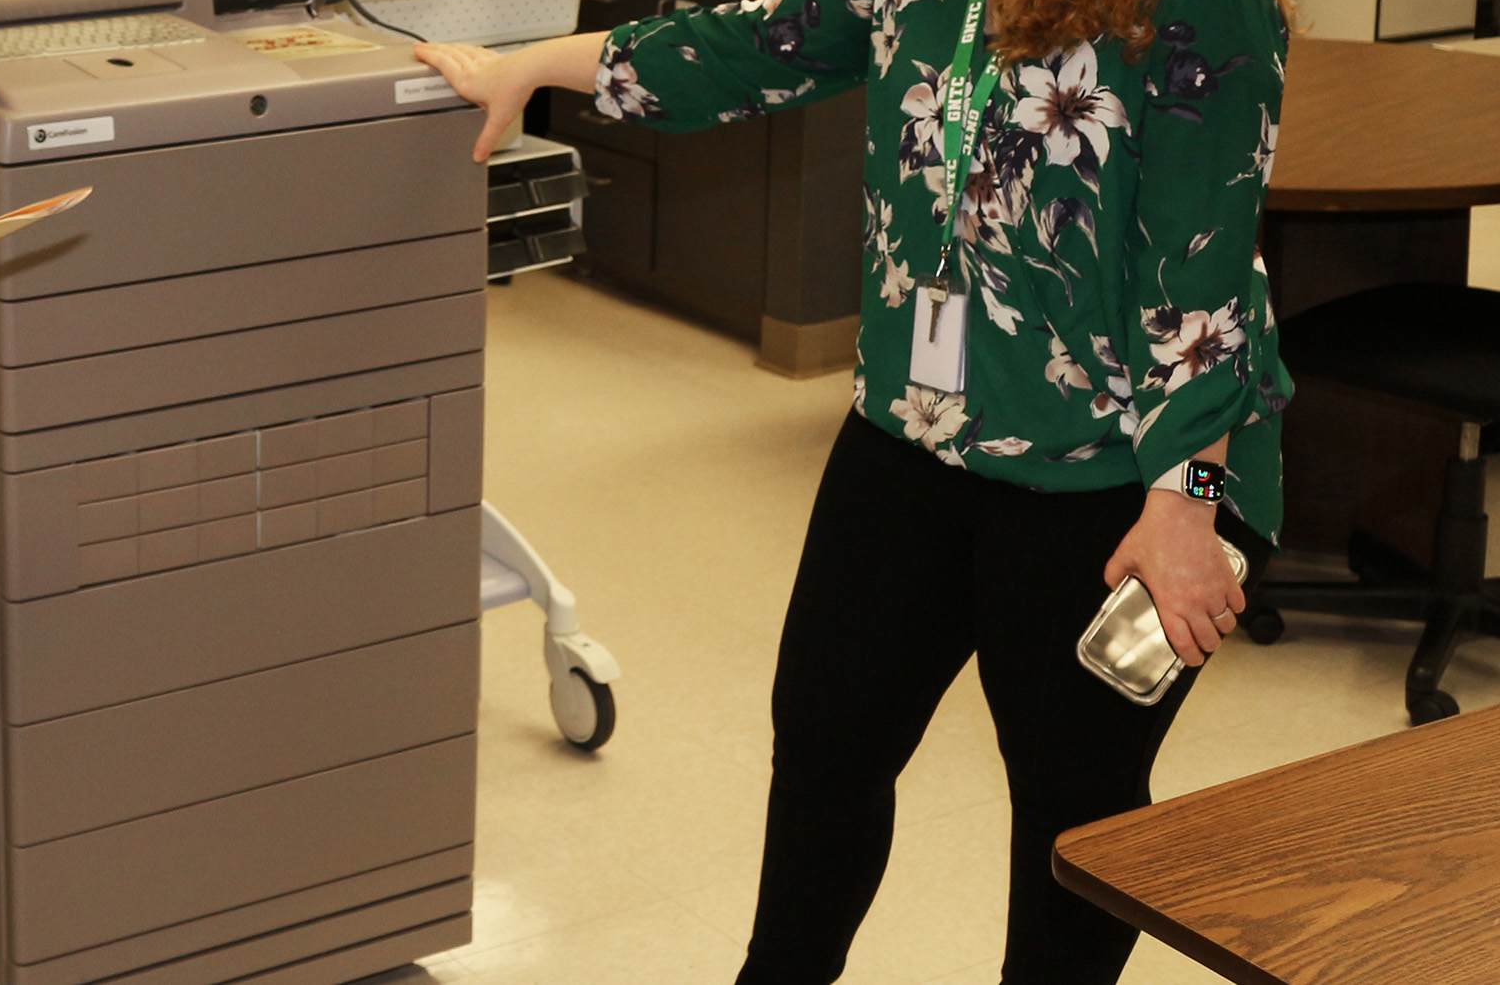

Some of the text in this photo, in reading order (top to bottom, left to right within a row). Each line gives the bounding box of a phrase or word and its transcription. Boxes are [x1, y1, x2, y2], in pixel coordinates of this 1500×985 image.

[961, 1, 982, 44] GNTC
[947, 76, 965, 122] GNTC
[962, 108, 980, 156] GNTC
